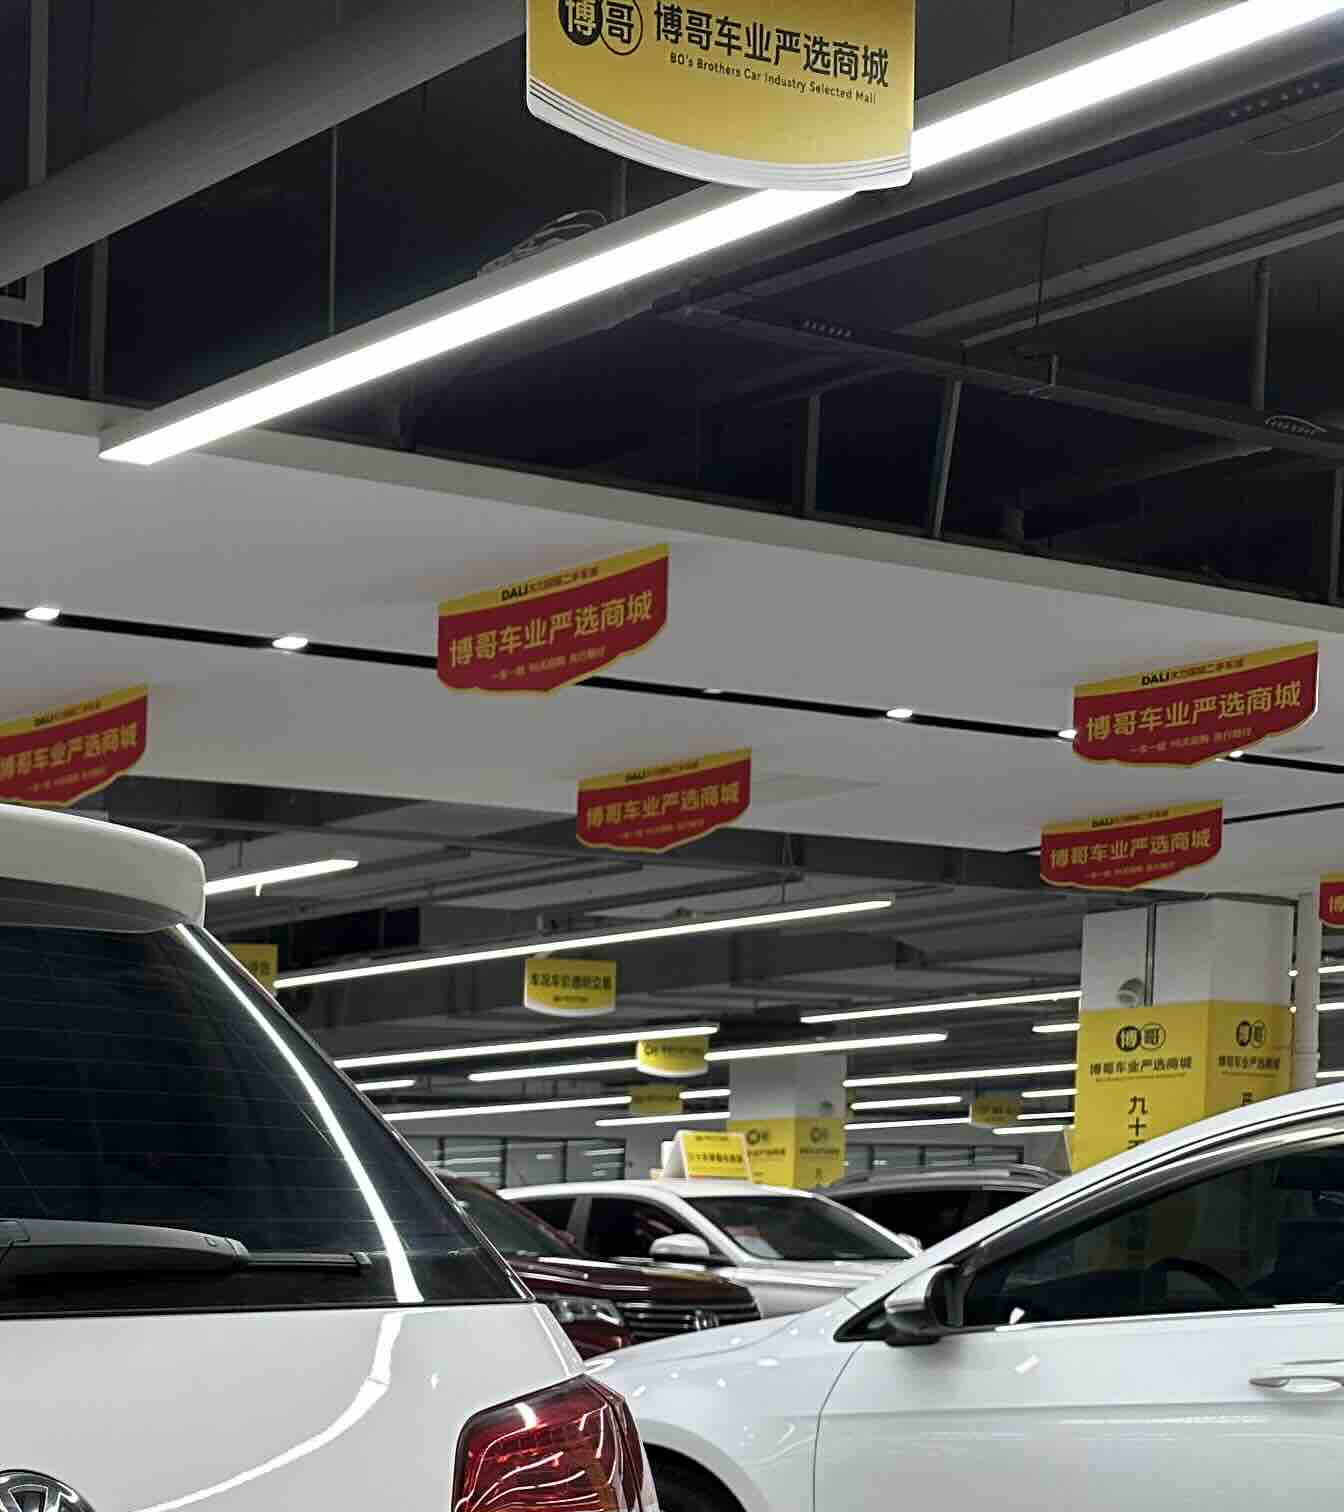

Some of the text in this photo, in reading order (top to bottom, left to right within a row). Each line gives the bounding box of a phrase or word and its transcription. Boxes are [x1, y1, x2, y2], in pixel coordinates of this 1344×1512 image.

[653, 2, 889, 88] 博哥车业严选商城
[696, 58, 741, 78] Brothers
[744, 68, 761, 81] Car
[764, 71, 807, 93] Industry
[809, 80, 853, 99] Selected
[448, 589, 655, 669] 博哥车业严选商城
[1086, 680, 1302, 742] 博哥车业严选商城
